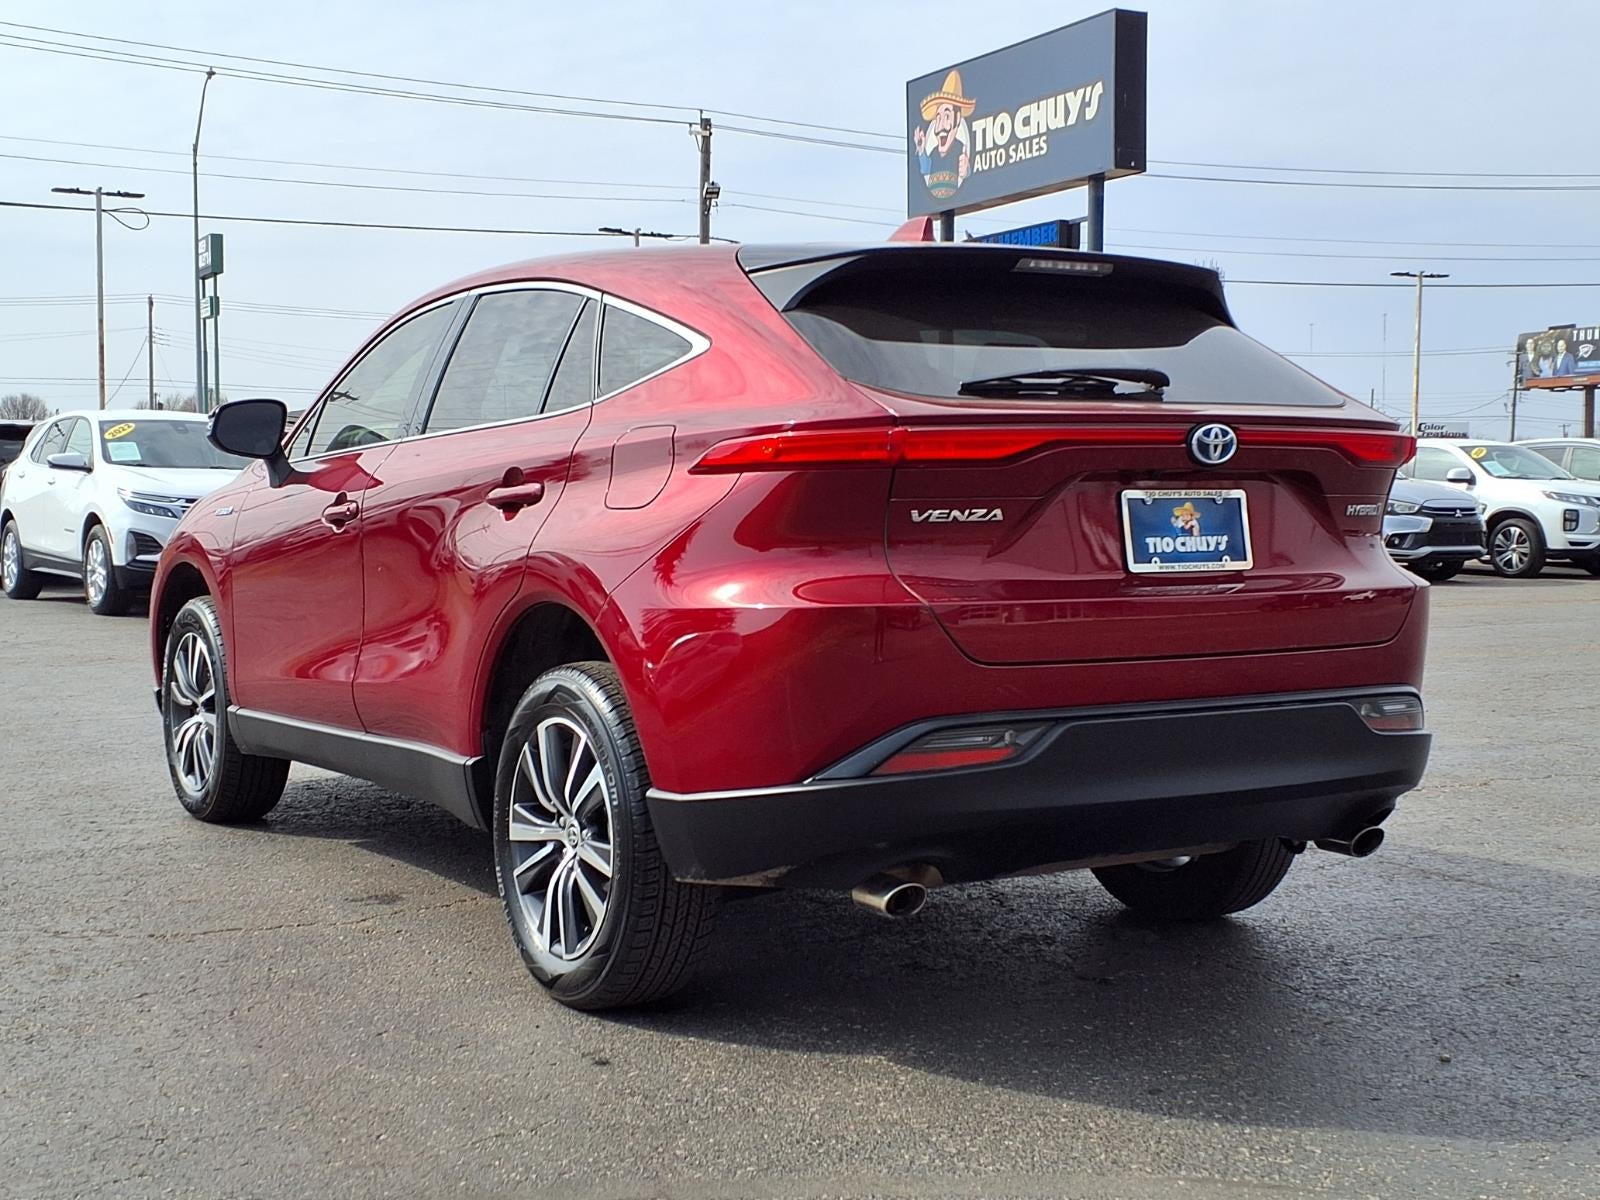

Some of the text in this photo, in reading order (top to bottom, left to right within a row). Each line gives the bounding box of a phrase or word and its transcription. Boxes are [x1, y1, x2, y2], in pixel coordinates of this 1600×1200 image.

[972, 81, 1103, 152] TIO CHUY'S
[973, 136, 1048, 173] AUTO SALES
[1417, 422, 1445, 433] Color
[911, 508, 1003, 522] VENZA
[1145, 534, 1228, 553] TIO CHUY'S
